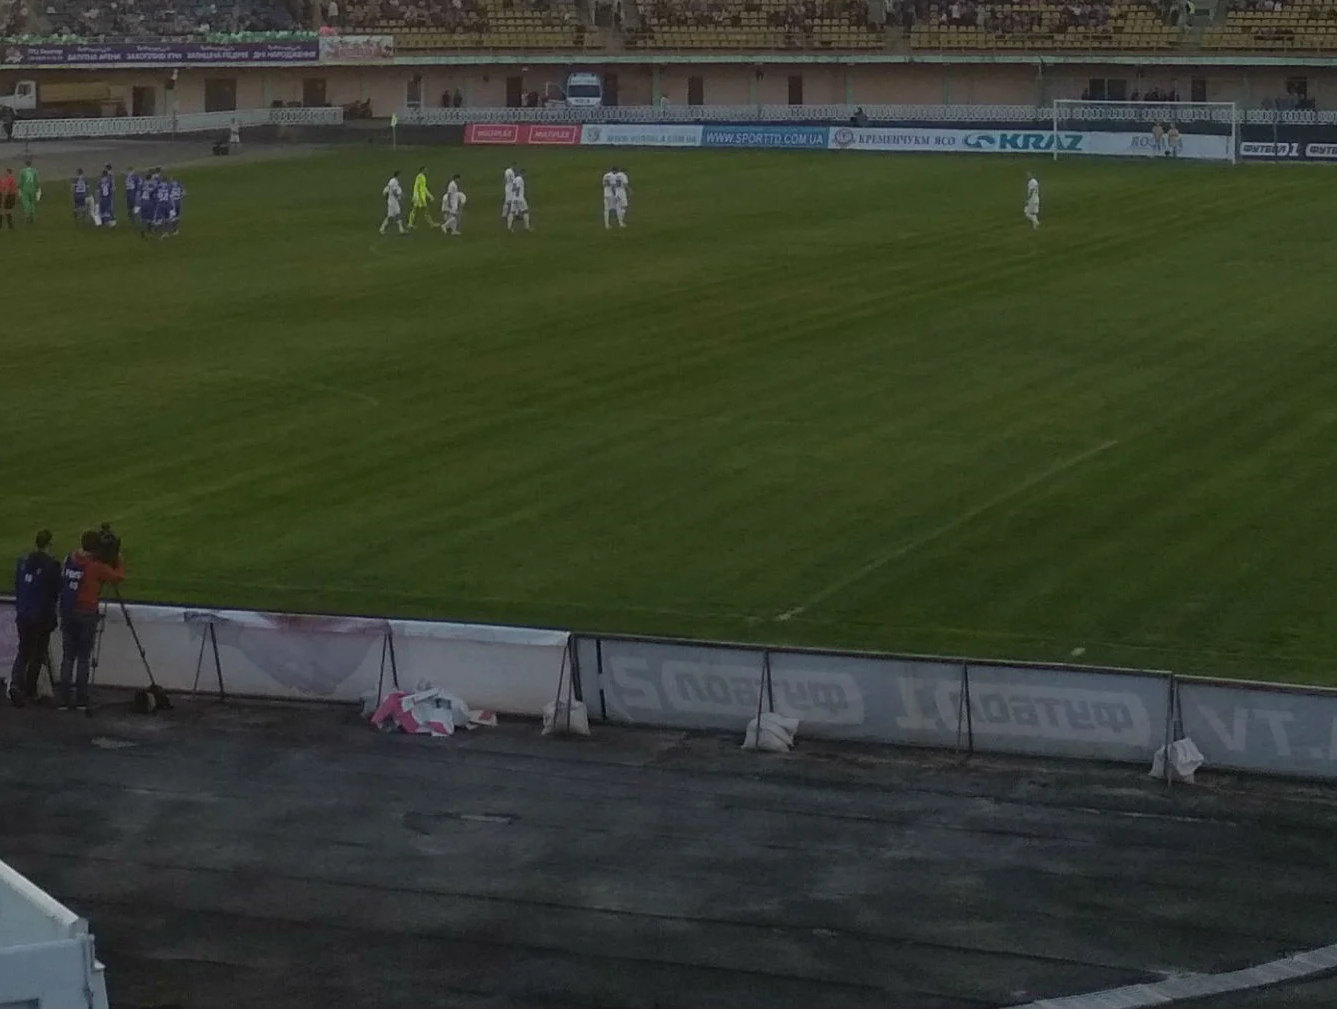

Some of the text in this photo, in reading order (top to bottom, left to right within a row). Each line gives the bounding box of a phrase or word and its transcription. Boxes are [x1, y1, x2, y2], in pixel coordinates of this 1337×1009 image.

[999, 133, 1083, 151] KRAZ
[1243, 142, 1300, 156] ФУТБОЛ 1
